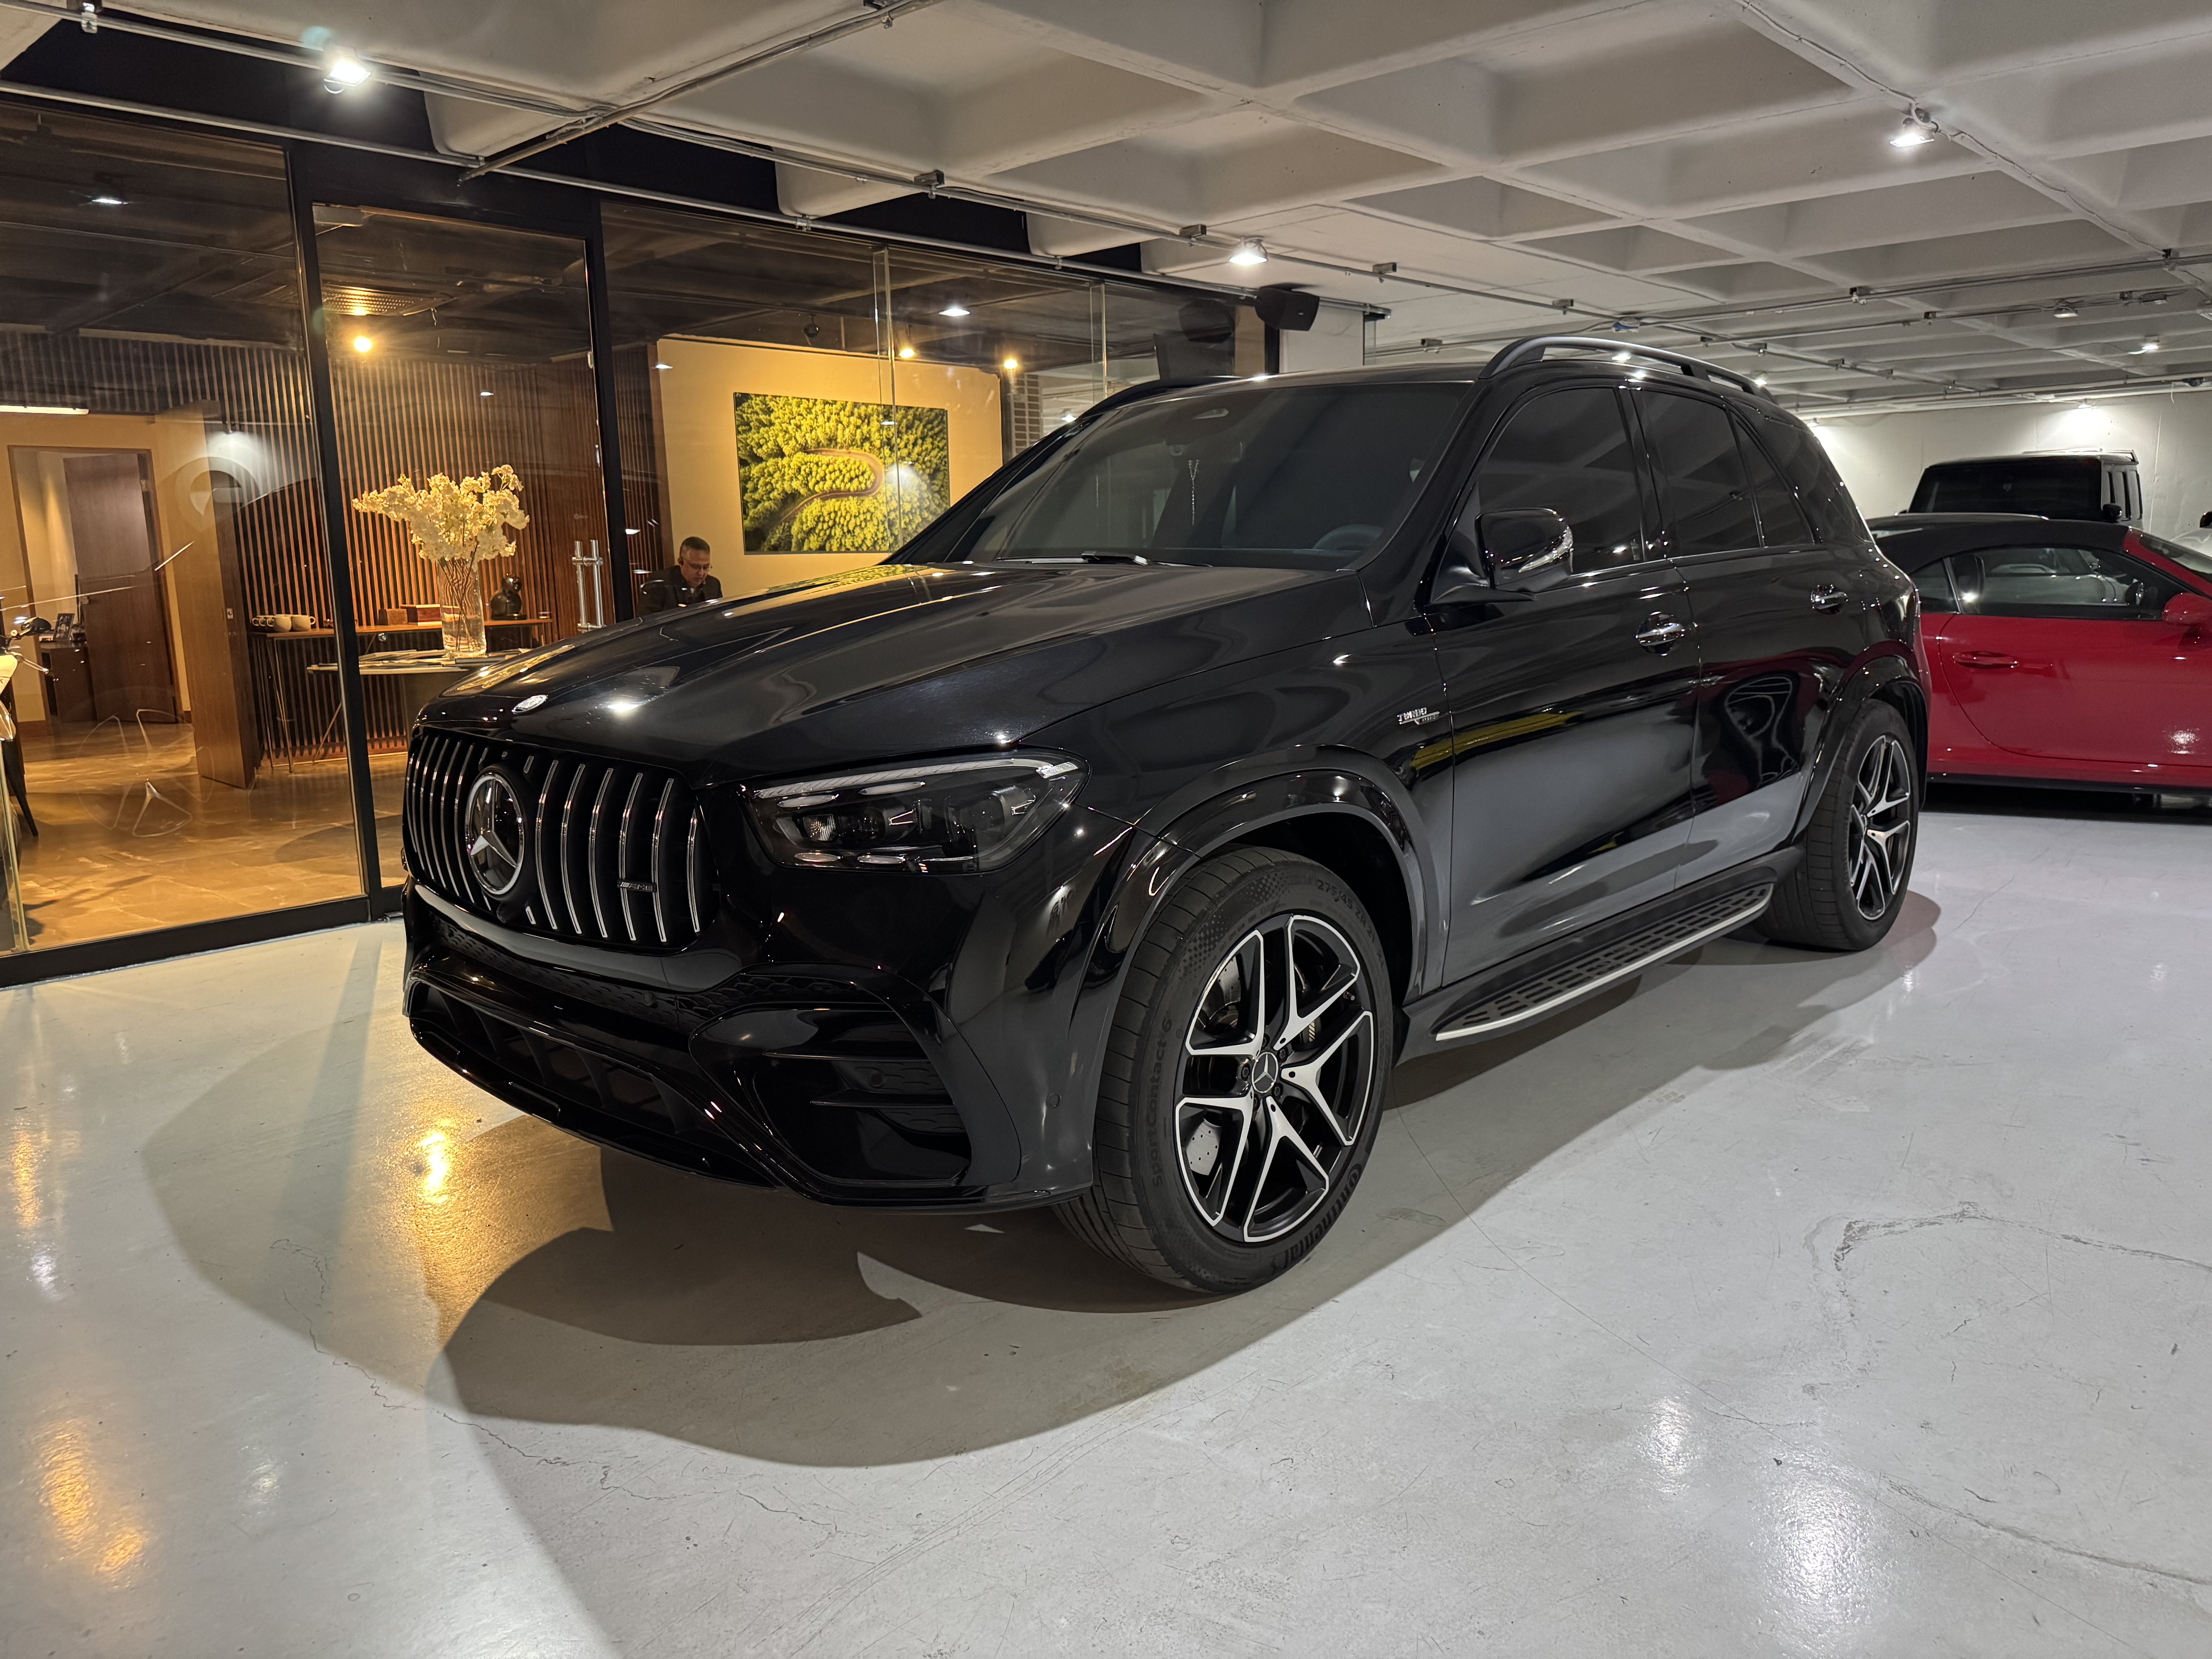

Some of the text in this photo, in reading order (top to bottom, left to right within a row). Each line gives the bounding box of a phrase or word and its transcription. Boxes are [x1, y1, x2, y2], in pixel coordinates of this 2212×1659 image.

[1317, 879, 1353, 908] 275/45
[1146, 1017, 1172, 1187] SportContact 6
[1283, 1163, 1362, 1268] Continental
